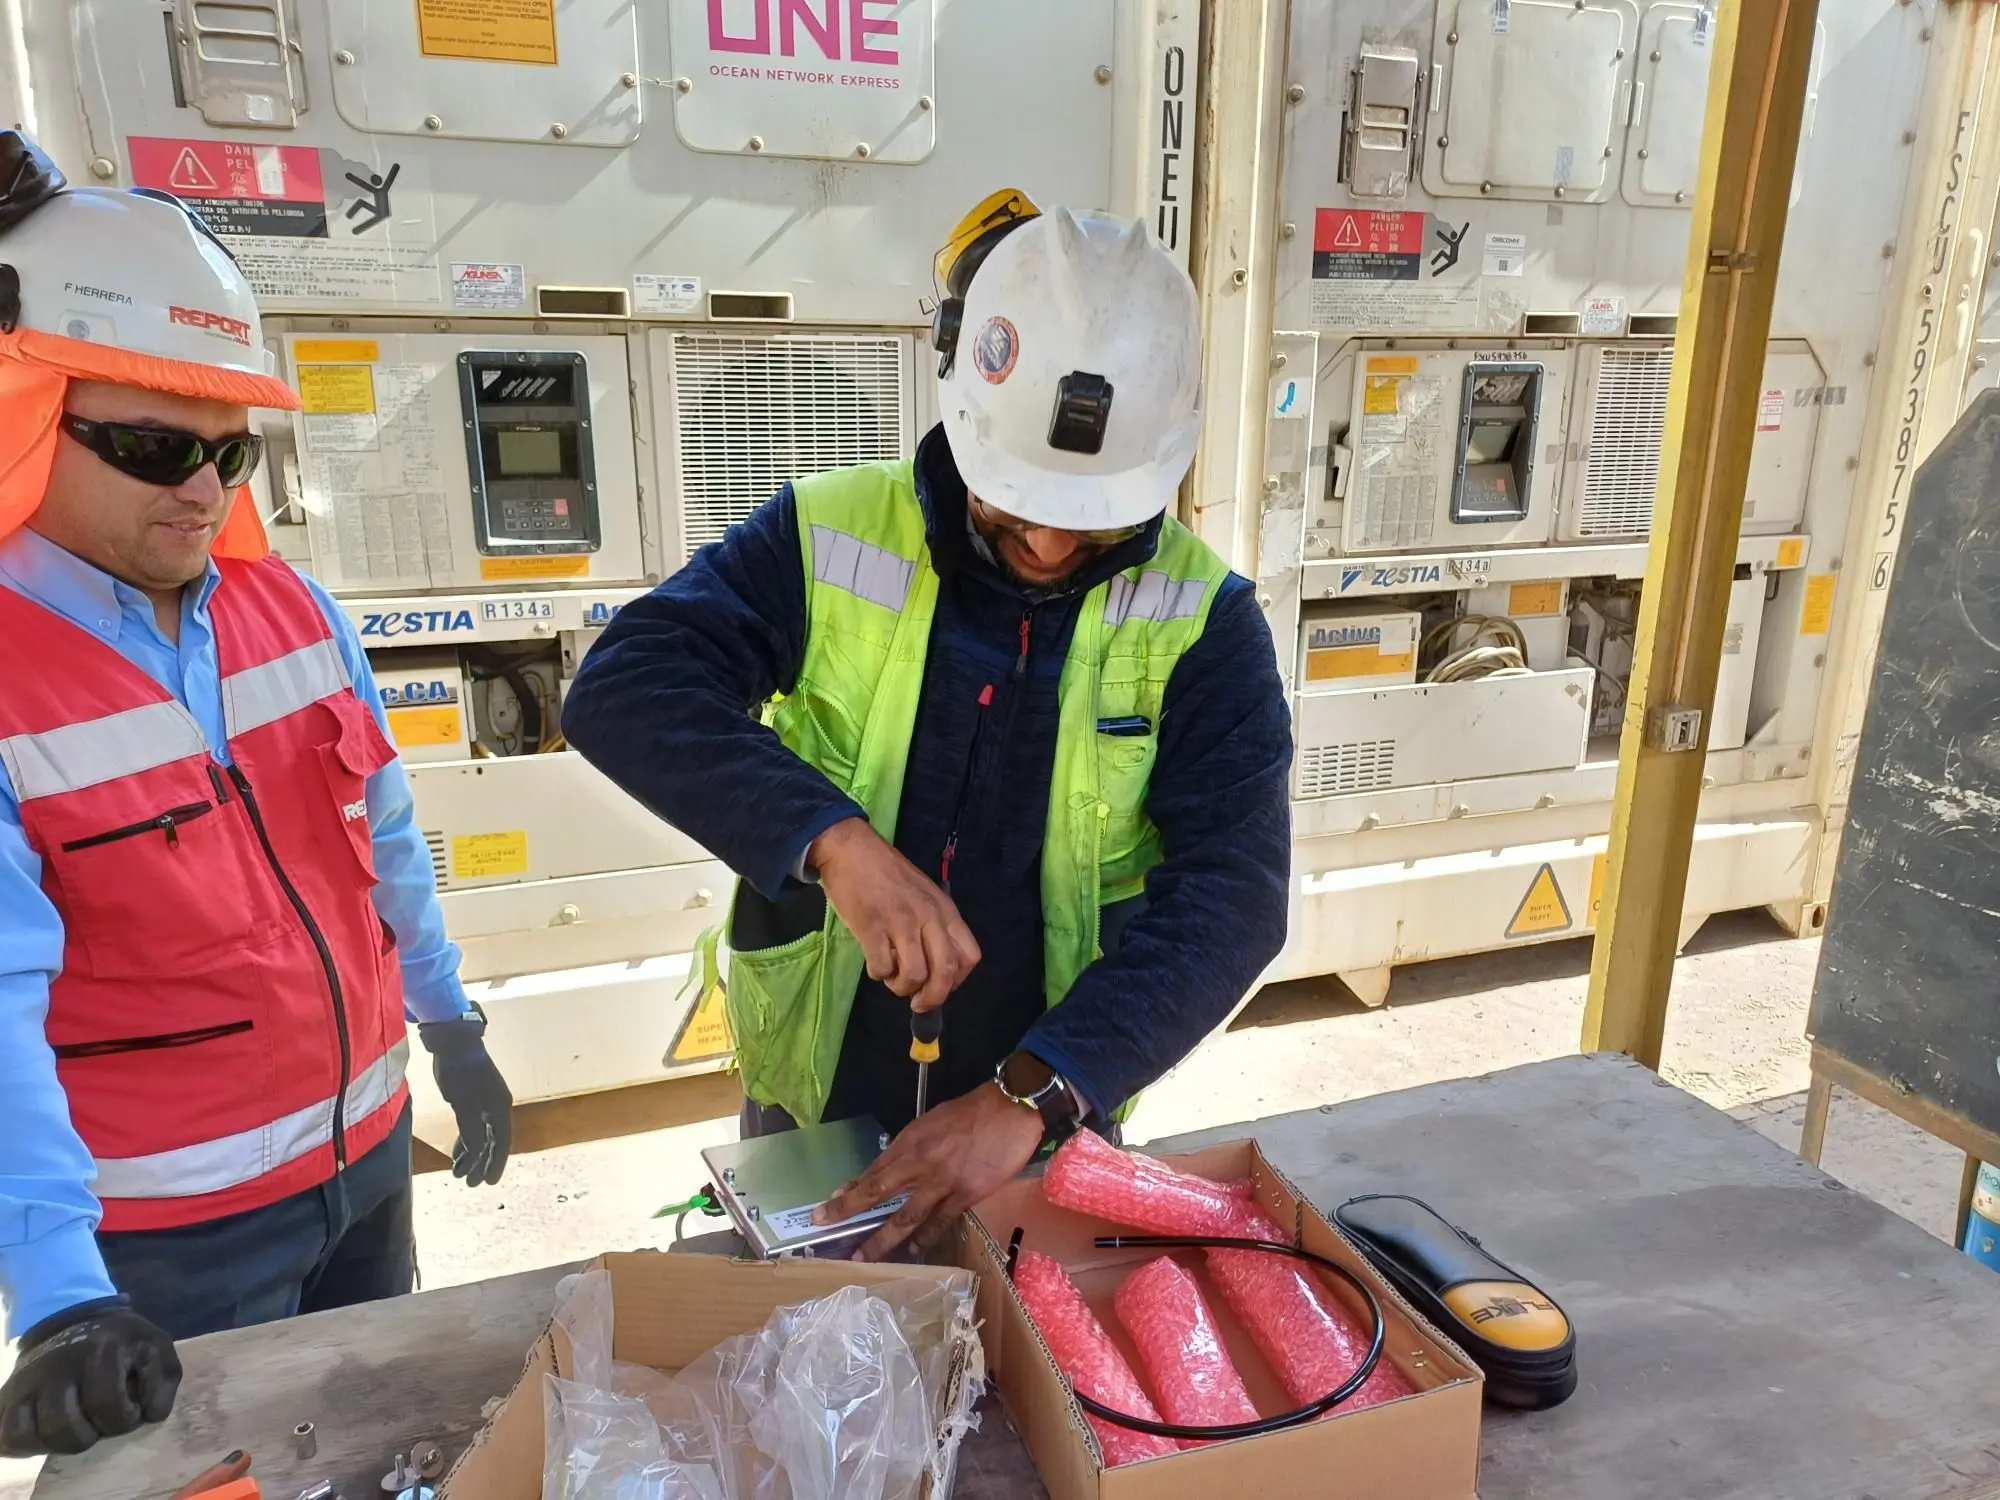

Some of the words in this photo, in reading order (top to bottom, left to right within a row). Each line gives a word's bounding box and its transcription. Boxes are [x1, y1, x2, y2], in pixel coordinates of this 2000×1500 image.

[707, 0, 899, 65] ONE
[710, 65, 760, 79] OCEAN
[767, 69, 834, 84] NETWORK
[841, 75, 900, 89] EXPRESS
[1932, 112, 1970, 274] FSCU
[64, 282, 73, 292] F
[75, 284, 133, 307] HERRERA
[169, 305, 250, 340] REPORT
[1883, 309, 1934, 537] 593875
[1874, 555, 1888, 588] 6
[485, 601, 551, 620] R134a
[404, 681, 449, 700] CA
[343, 800, 367, 822] RE
[697, 1023, 723, 1034] SUPE
